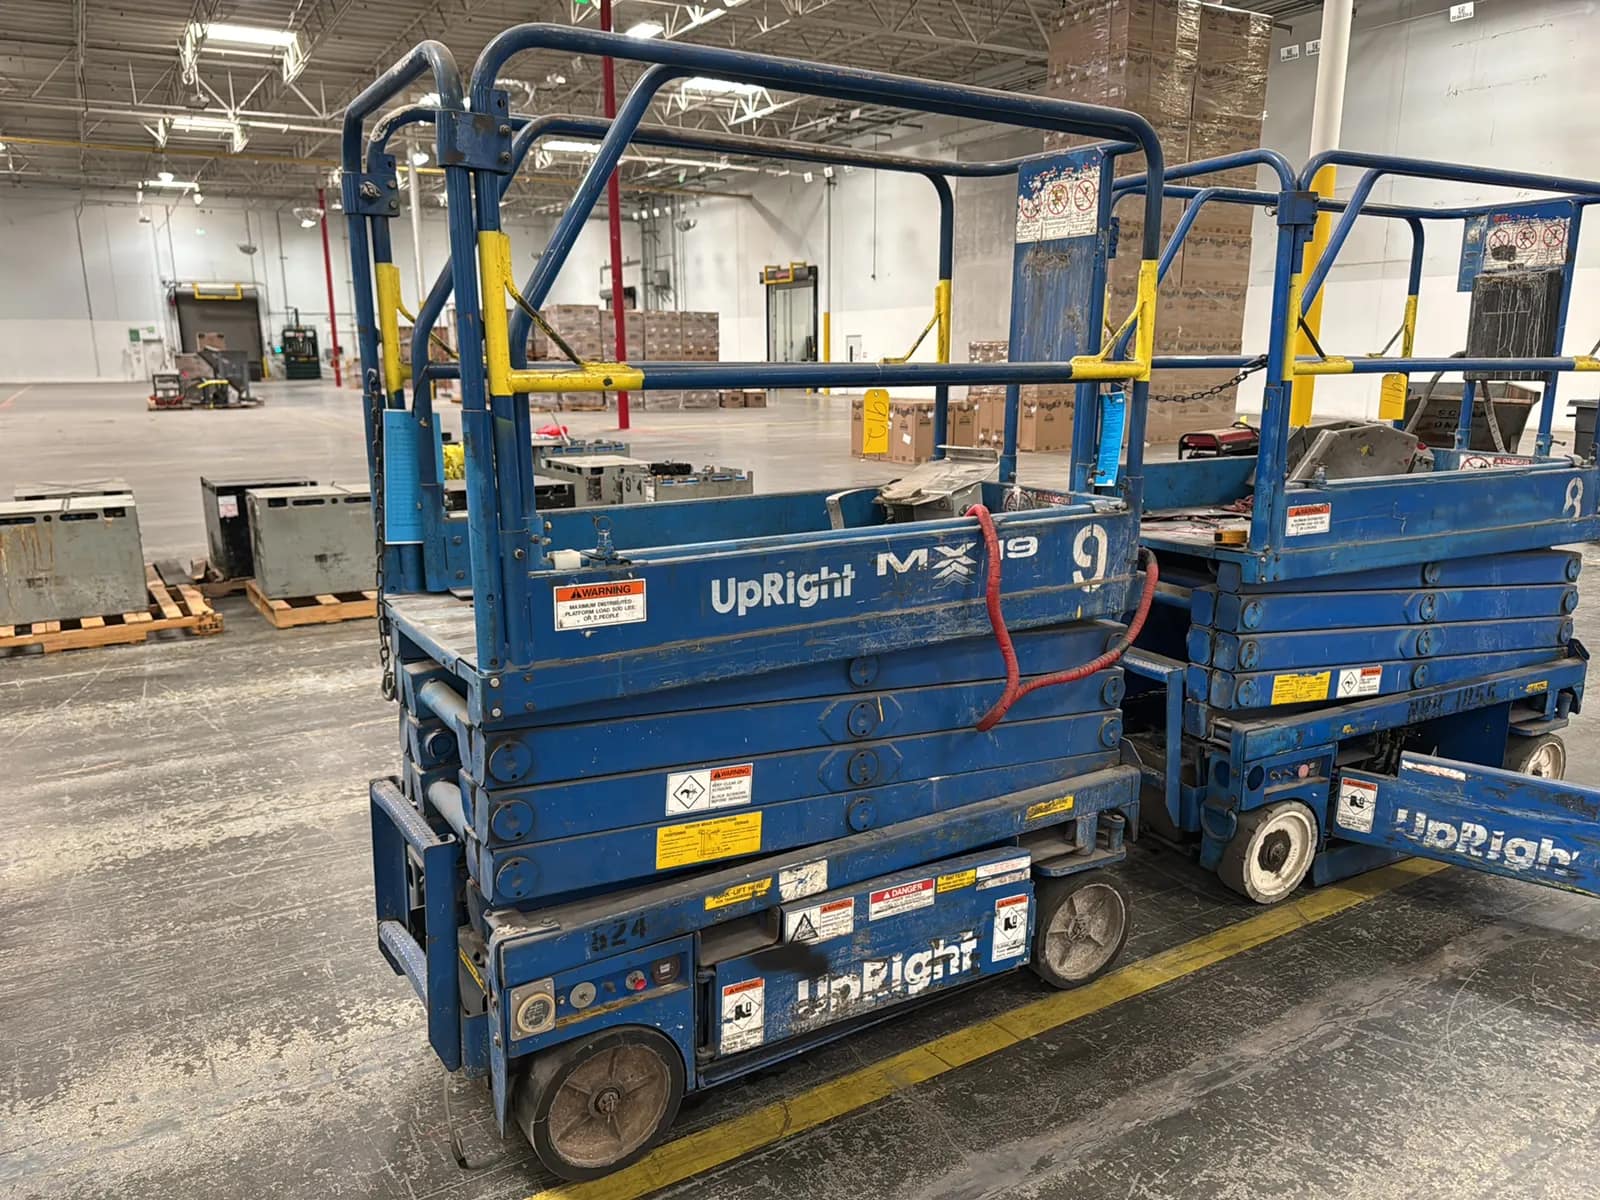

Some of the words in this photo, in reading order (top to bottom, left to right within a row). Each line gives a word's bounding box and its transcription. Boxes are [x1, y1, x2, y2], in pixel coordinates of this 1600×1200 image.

[1072, 523, 1110, 593] 9
[581, 584, 631, 598] WARNING
[711, 563, 856, 616] UpRight
[565, 608, 595, 617] PLATFORM
[595, 607, 611, 615] LOAD
[569, 602, 596, 611] MAXIMUM
[1395, 807, 1580, 876] UpRigh
[891, 883, 924, 898] DANGER
